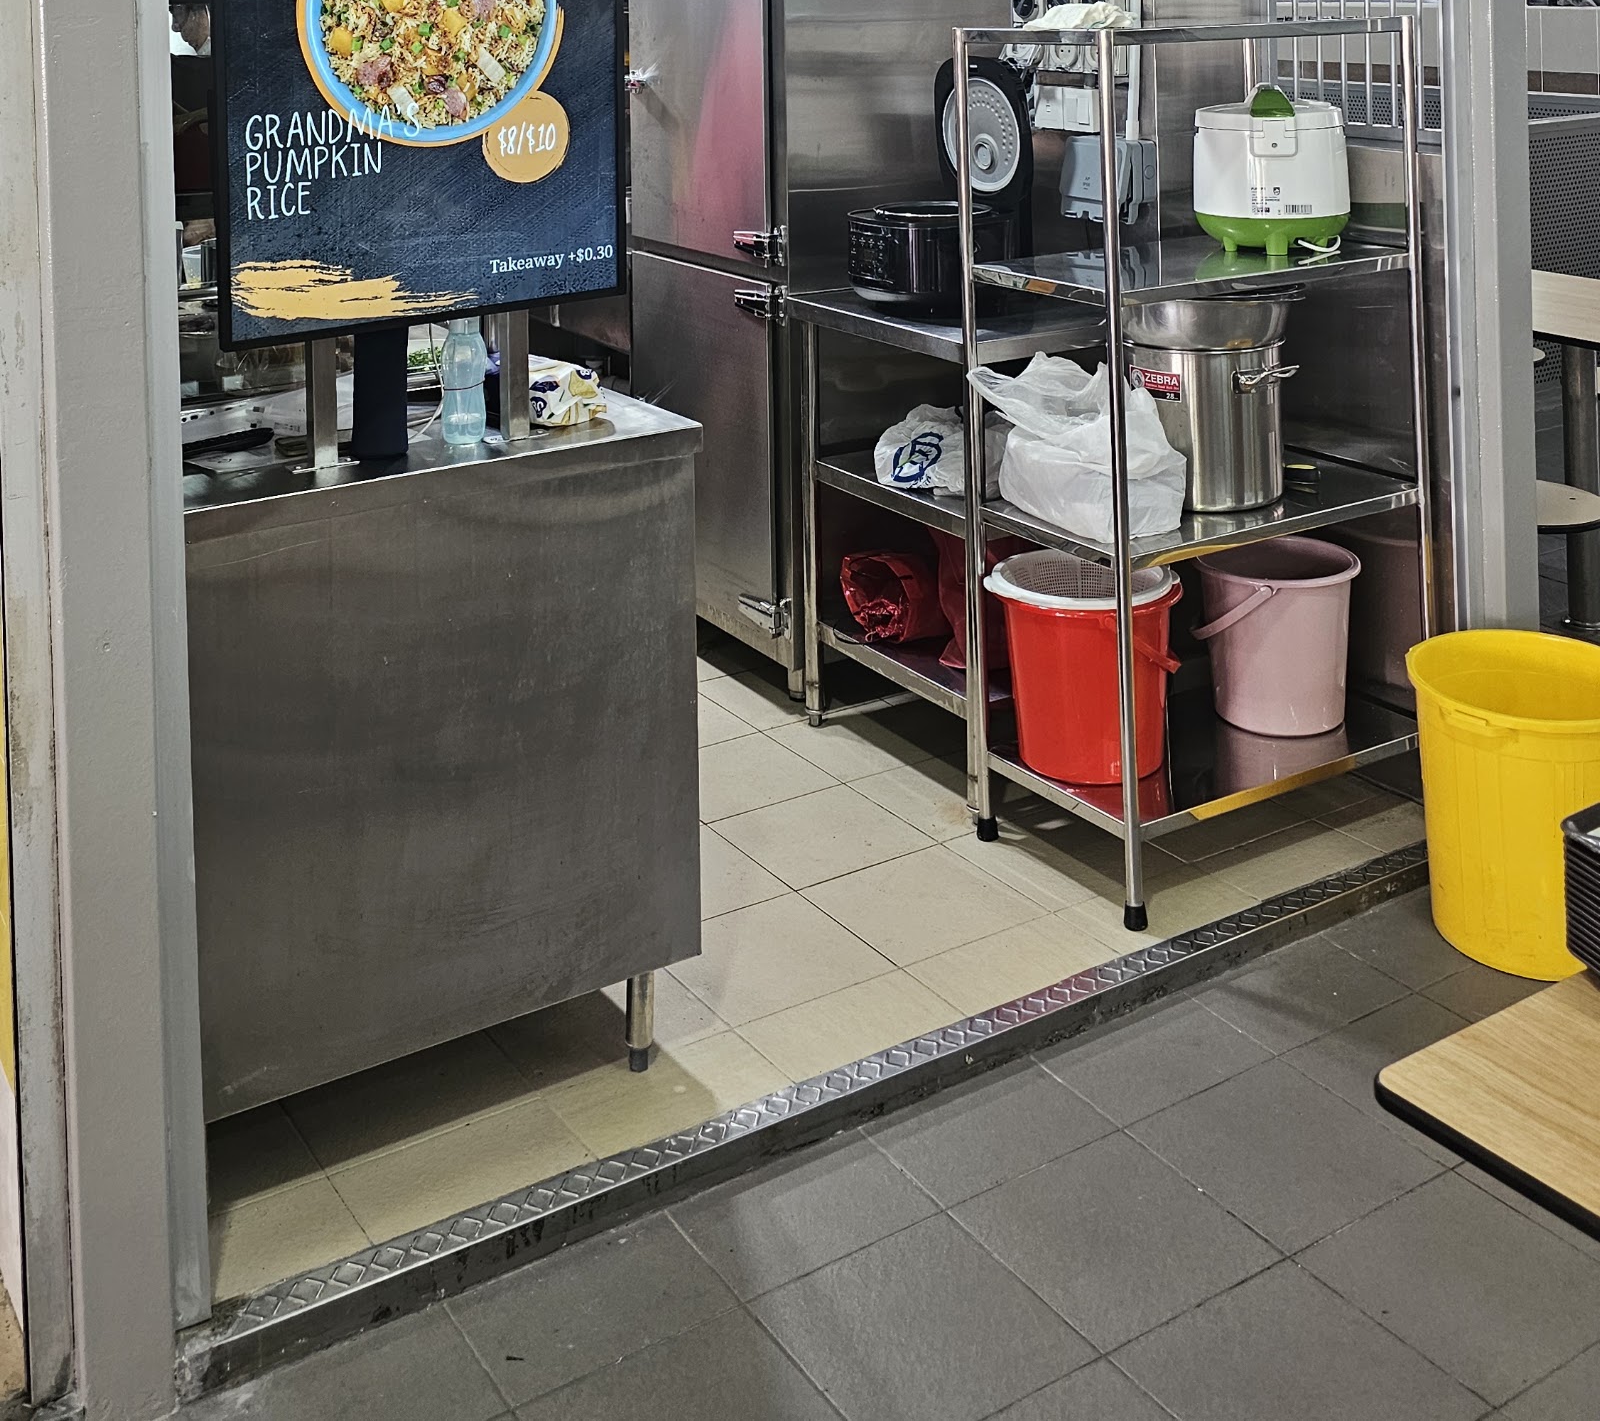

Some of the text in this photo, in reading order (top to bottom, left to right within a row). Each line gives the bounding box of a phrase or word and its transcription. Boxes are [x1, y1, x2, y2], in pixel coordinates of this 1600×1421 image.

[245, 100, 421, 151] GRANDMA'S
[497, 120, 557, 157] $8/$10
[245, 141, 383, 187] PUMPKIN
[246, 181, 312, 221] RICE
[489, 244, 614, 274] Takeaway +$0.30
[1144, 372, 1179, 386] ZEBRA
